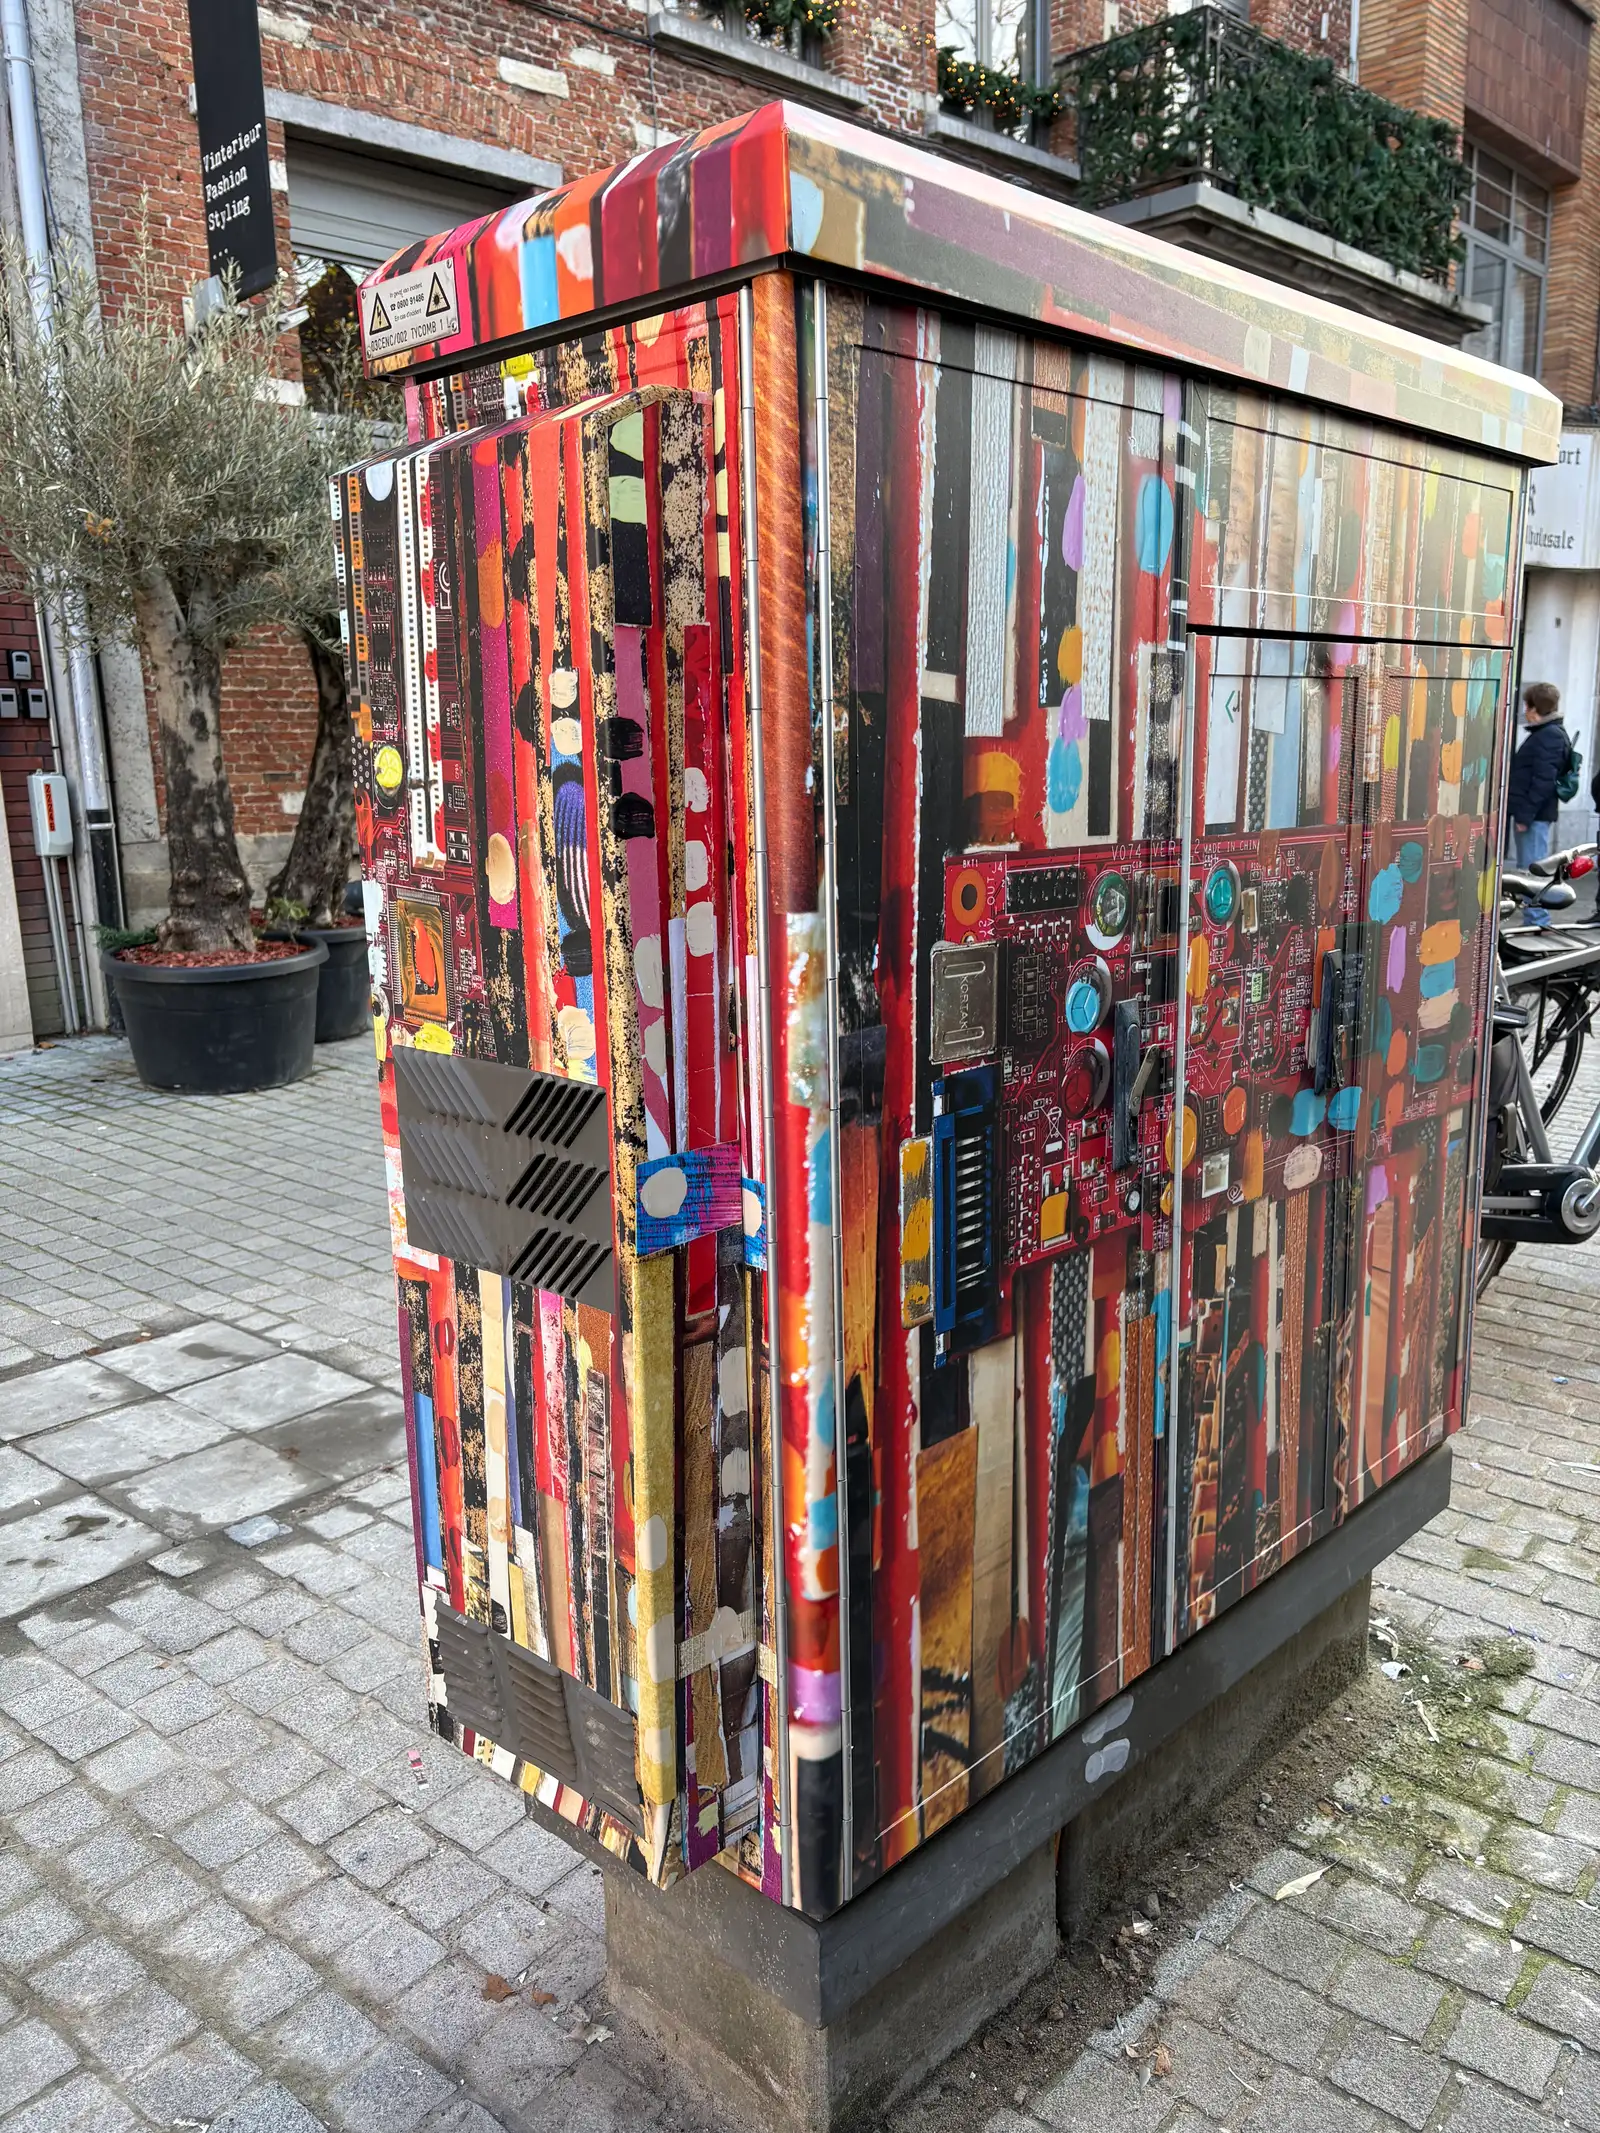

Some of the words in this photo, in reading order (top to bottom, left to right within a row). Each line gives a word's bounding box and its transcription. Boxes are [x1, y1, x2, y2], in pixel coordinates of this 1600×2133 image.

[202, 122, 262, 173] Vinterieur
[205, 165, 248, 203] Fashion
[208, 195, 251, 231] Styling
[410, 321, 437, 340] TYCOMB
[1558, 447, 1582, 465] ort
[1204, 842, 1221, 854] MADE
[1227, 841, 1236, 852] IN
[986, 877, 995, 906] OUT
